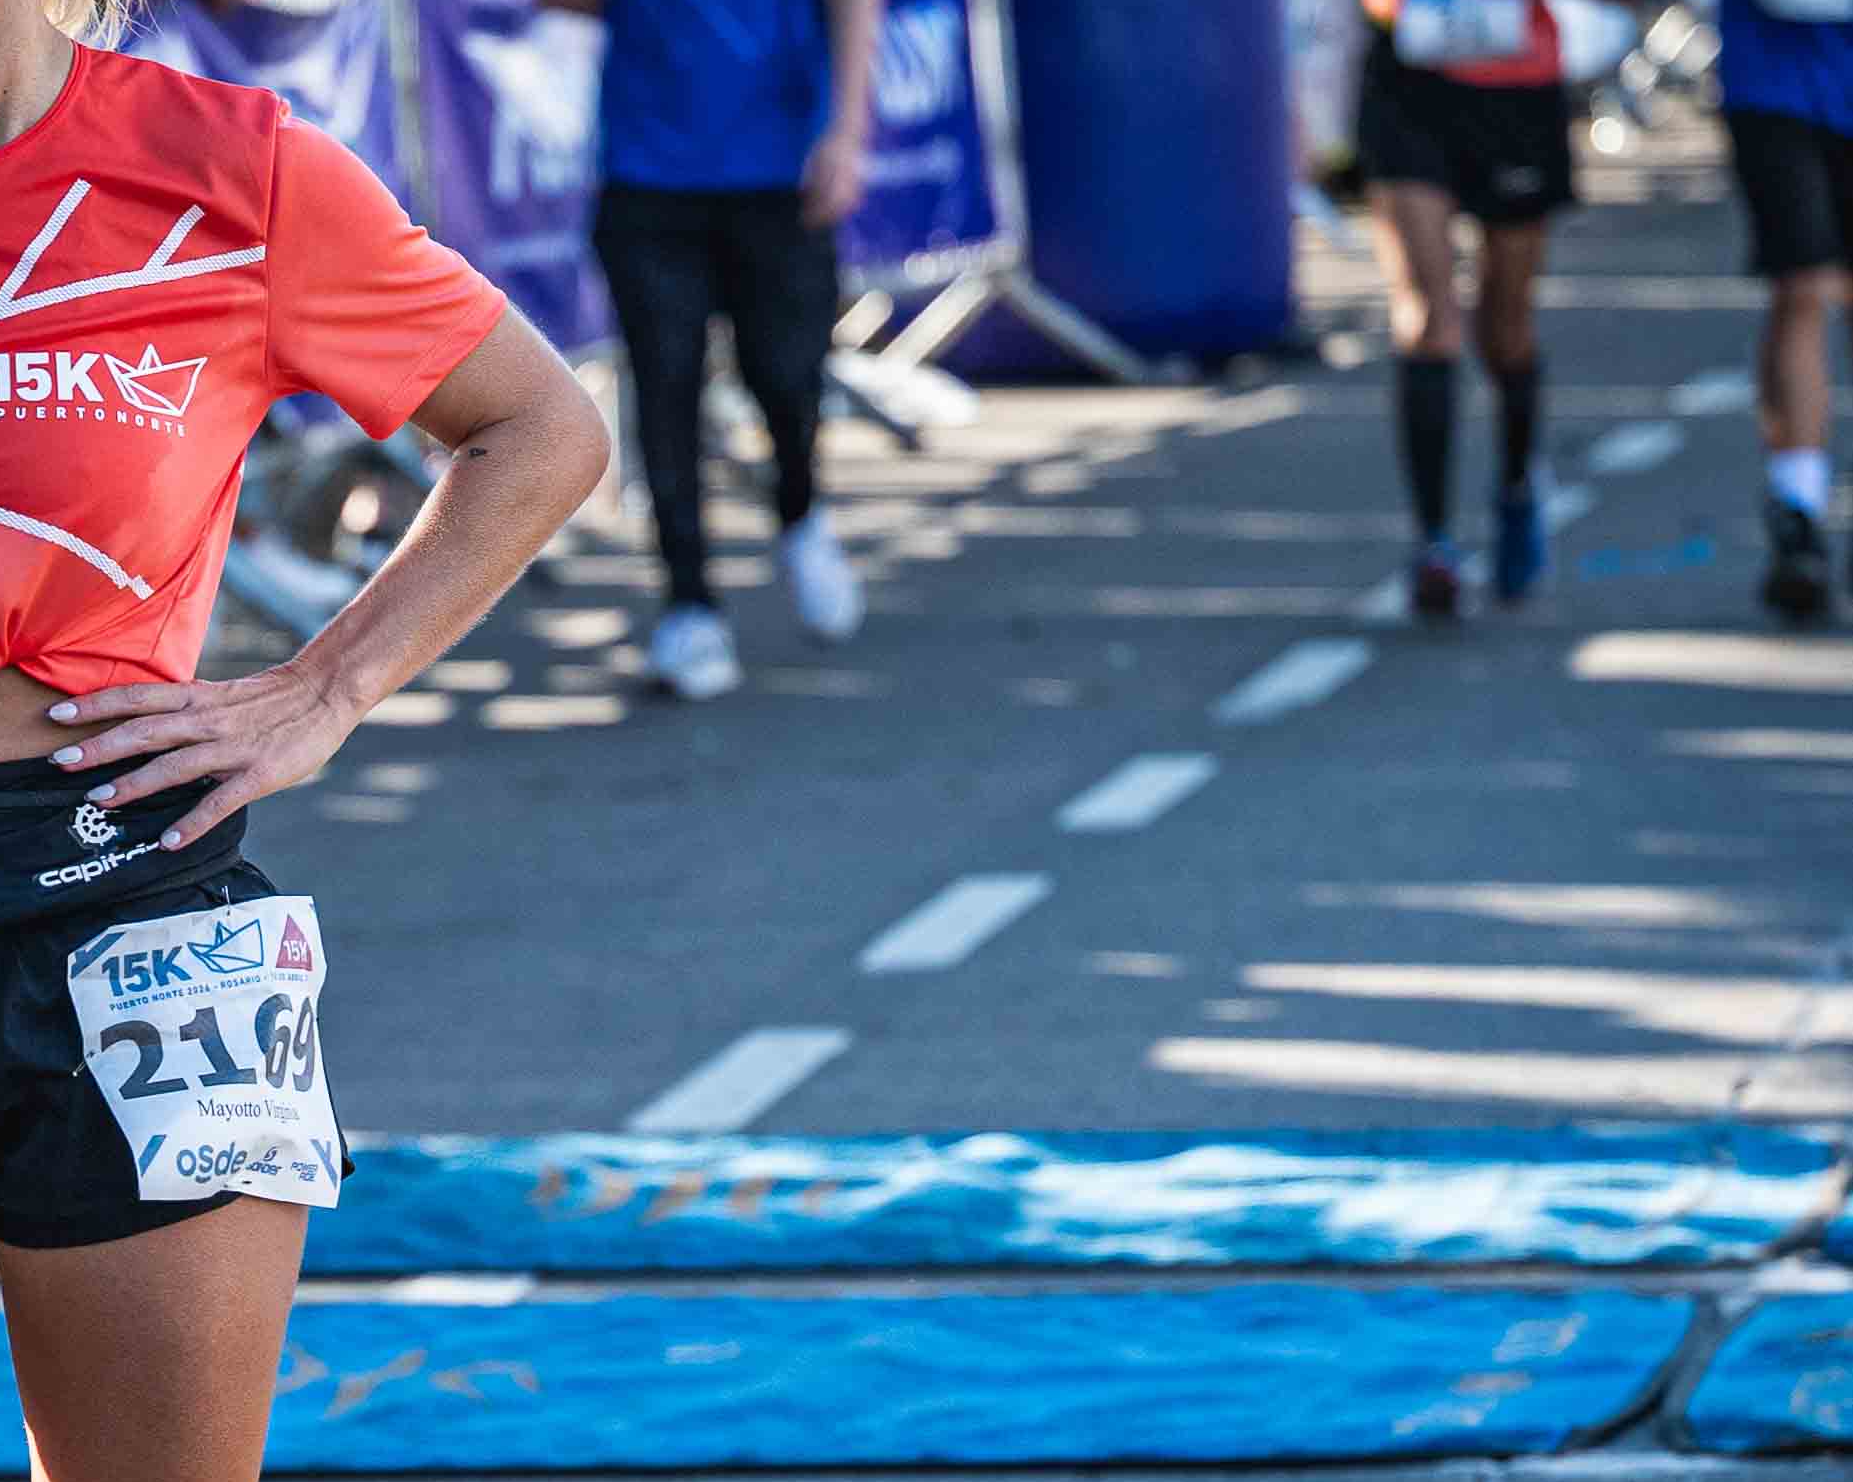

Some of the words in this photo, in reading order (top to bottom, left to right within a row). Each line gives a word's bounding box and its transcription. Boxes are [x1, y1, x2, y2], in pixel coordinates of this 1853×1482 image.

[116, 410, 186, 438] NORTE
[282, 939, 308, 964] 15K
[101, 945, 192, 997] 15K
[109, 997, 149, 1012] PUERTO
[152, 987, 184, 1002] NORTE
[220, 975, 261, 991] ROSARIO
[100, 993, 315, 1100] 2169
[197, 1099, 261, 1121] Mayotto
[176, 1142, 248, 1180] osde
